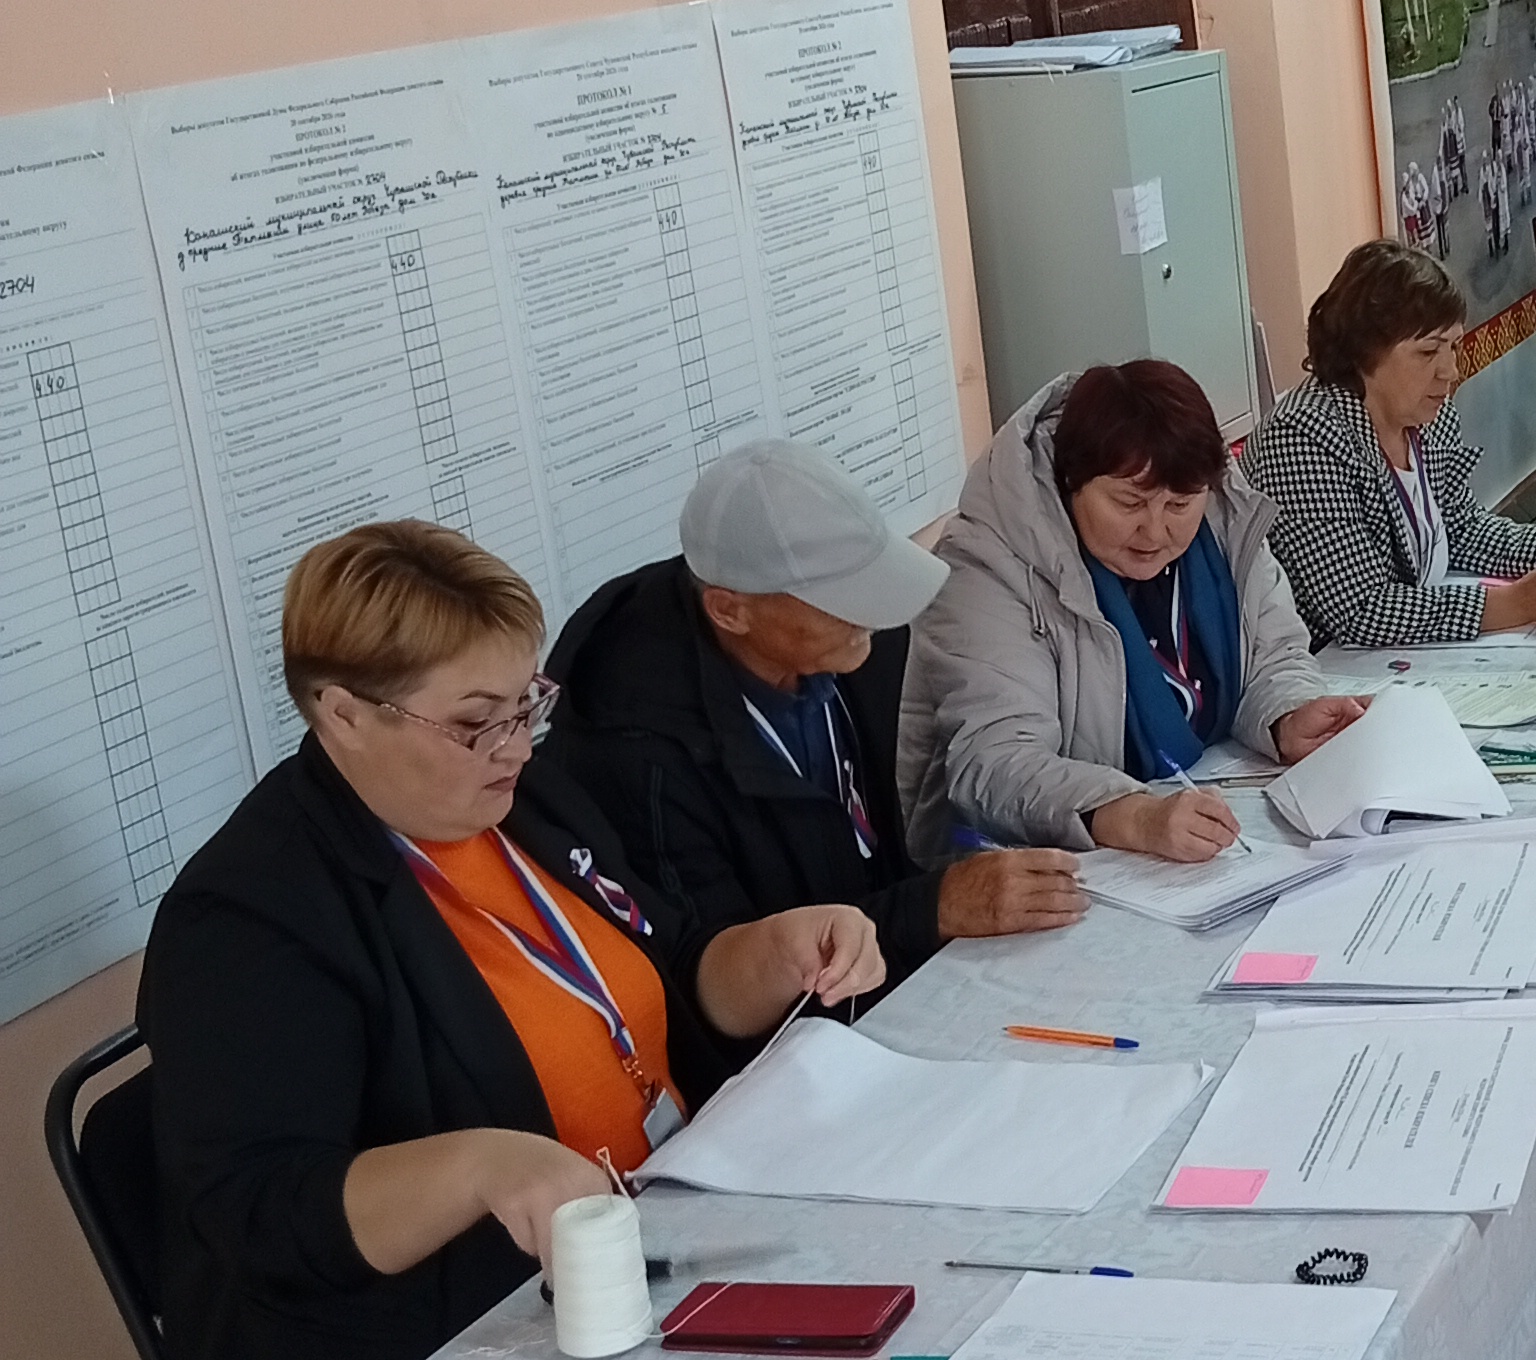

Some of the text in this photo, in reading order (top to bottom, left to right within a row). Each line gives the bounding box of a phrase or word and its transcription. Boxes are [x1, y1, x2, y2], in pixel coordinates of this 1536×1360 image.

[576, 87, 618, 105] ПРОТОКОЛ
[658, 210, 677, 230] 440
[391, 254, 415, 273] 440
[0, 273, 35, 299] 2704
[34, 376, 65, 398] 440
